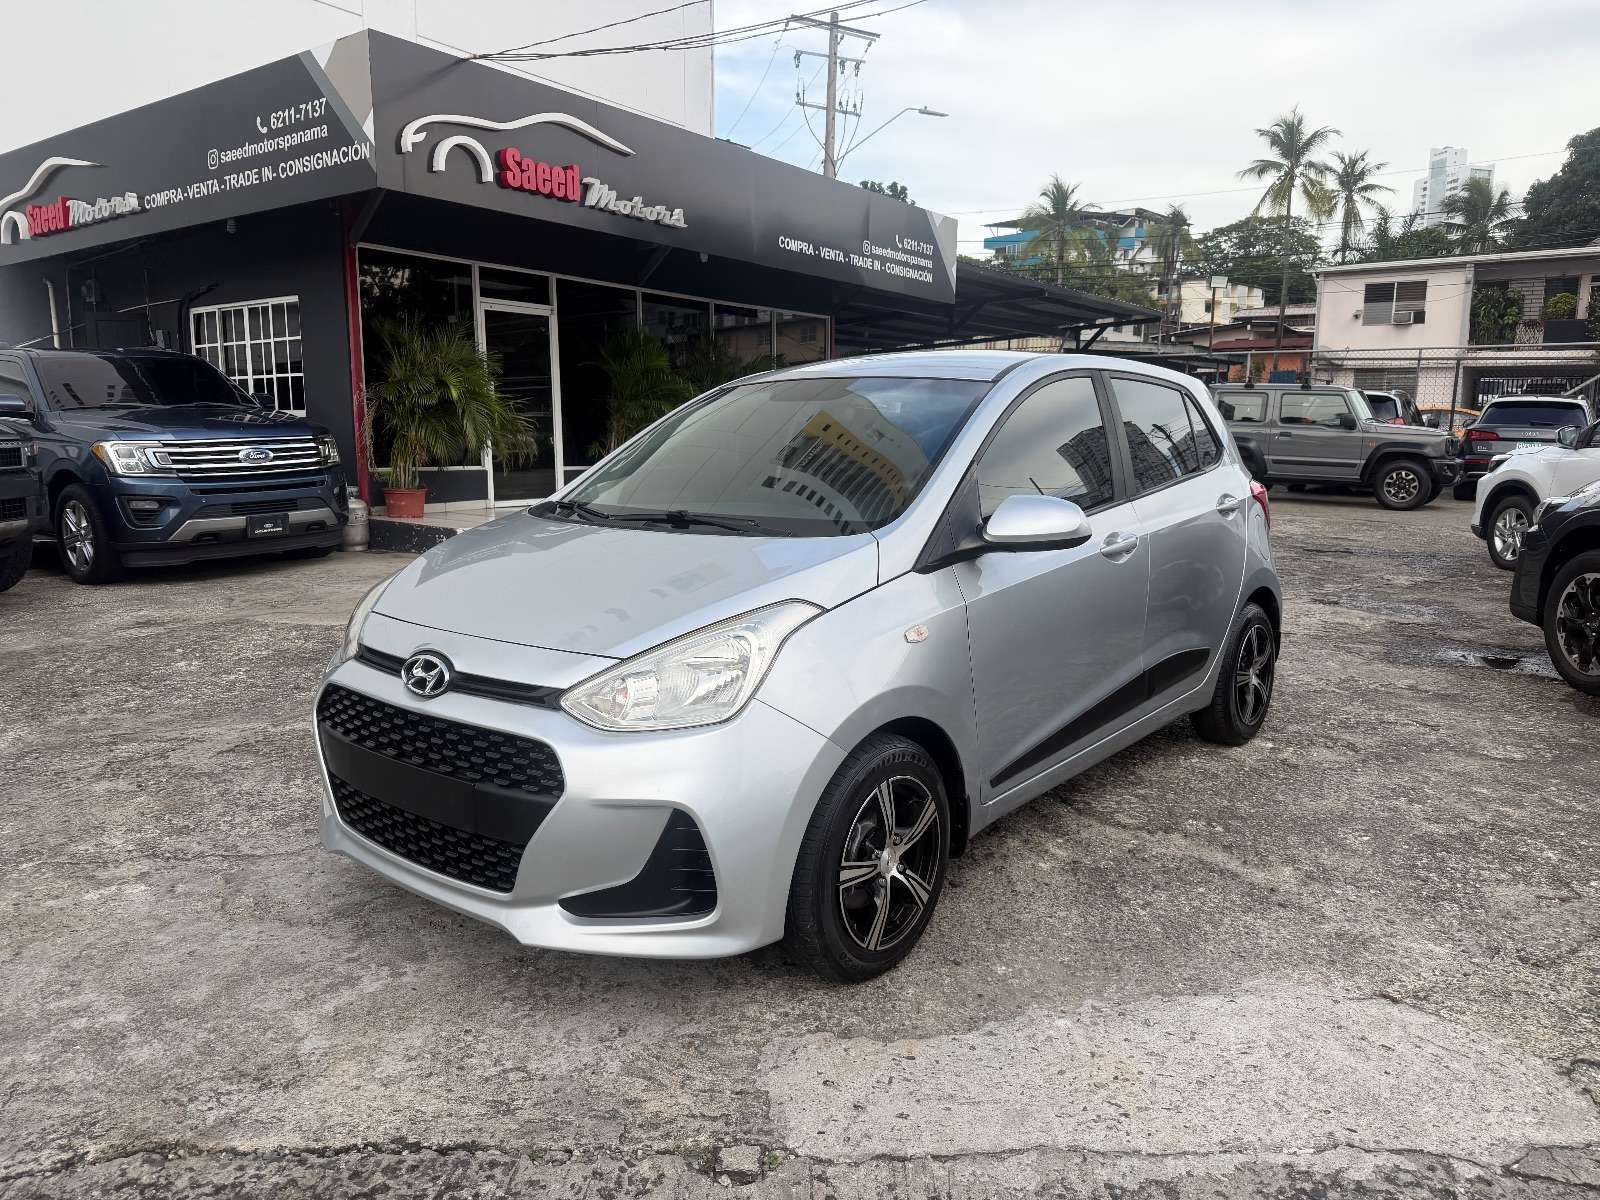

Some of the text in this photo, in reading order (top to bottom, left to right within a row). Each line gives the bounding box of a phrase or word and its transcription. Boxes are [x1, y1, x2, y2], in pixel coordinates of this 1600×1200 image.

[270, 97, 327, 130] 6211-7137
[220, 124, 328, 164] saeedmotorspanama
[278, 140, 370, 179] CONSIGNACIÓN
[502, 147, 688, 229] Saeed Motors
[25, 195, 70, 236] Saeed
[778, 235, 815, 256] COMPRA
[819, 246, 845, 263] VENTA
[849, 254, 873, 270] TRADE
[873, 260, 881, 271] IN
[885, 262, 933, 283] CONSIGNACIÓN
[871, 245, 933, 268] saeedmotorspanama
[903, 238, 934, 256] 6211-7137
